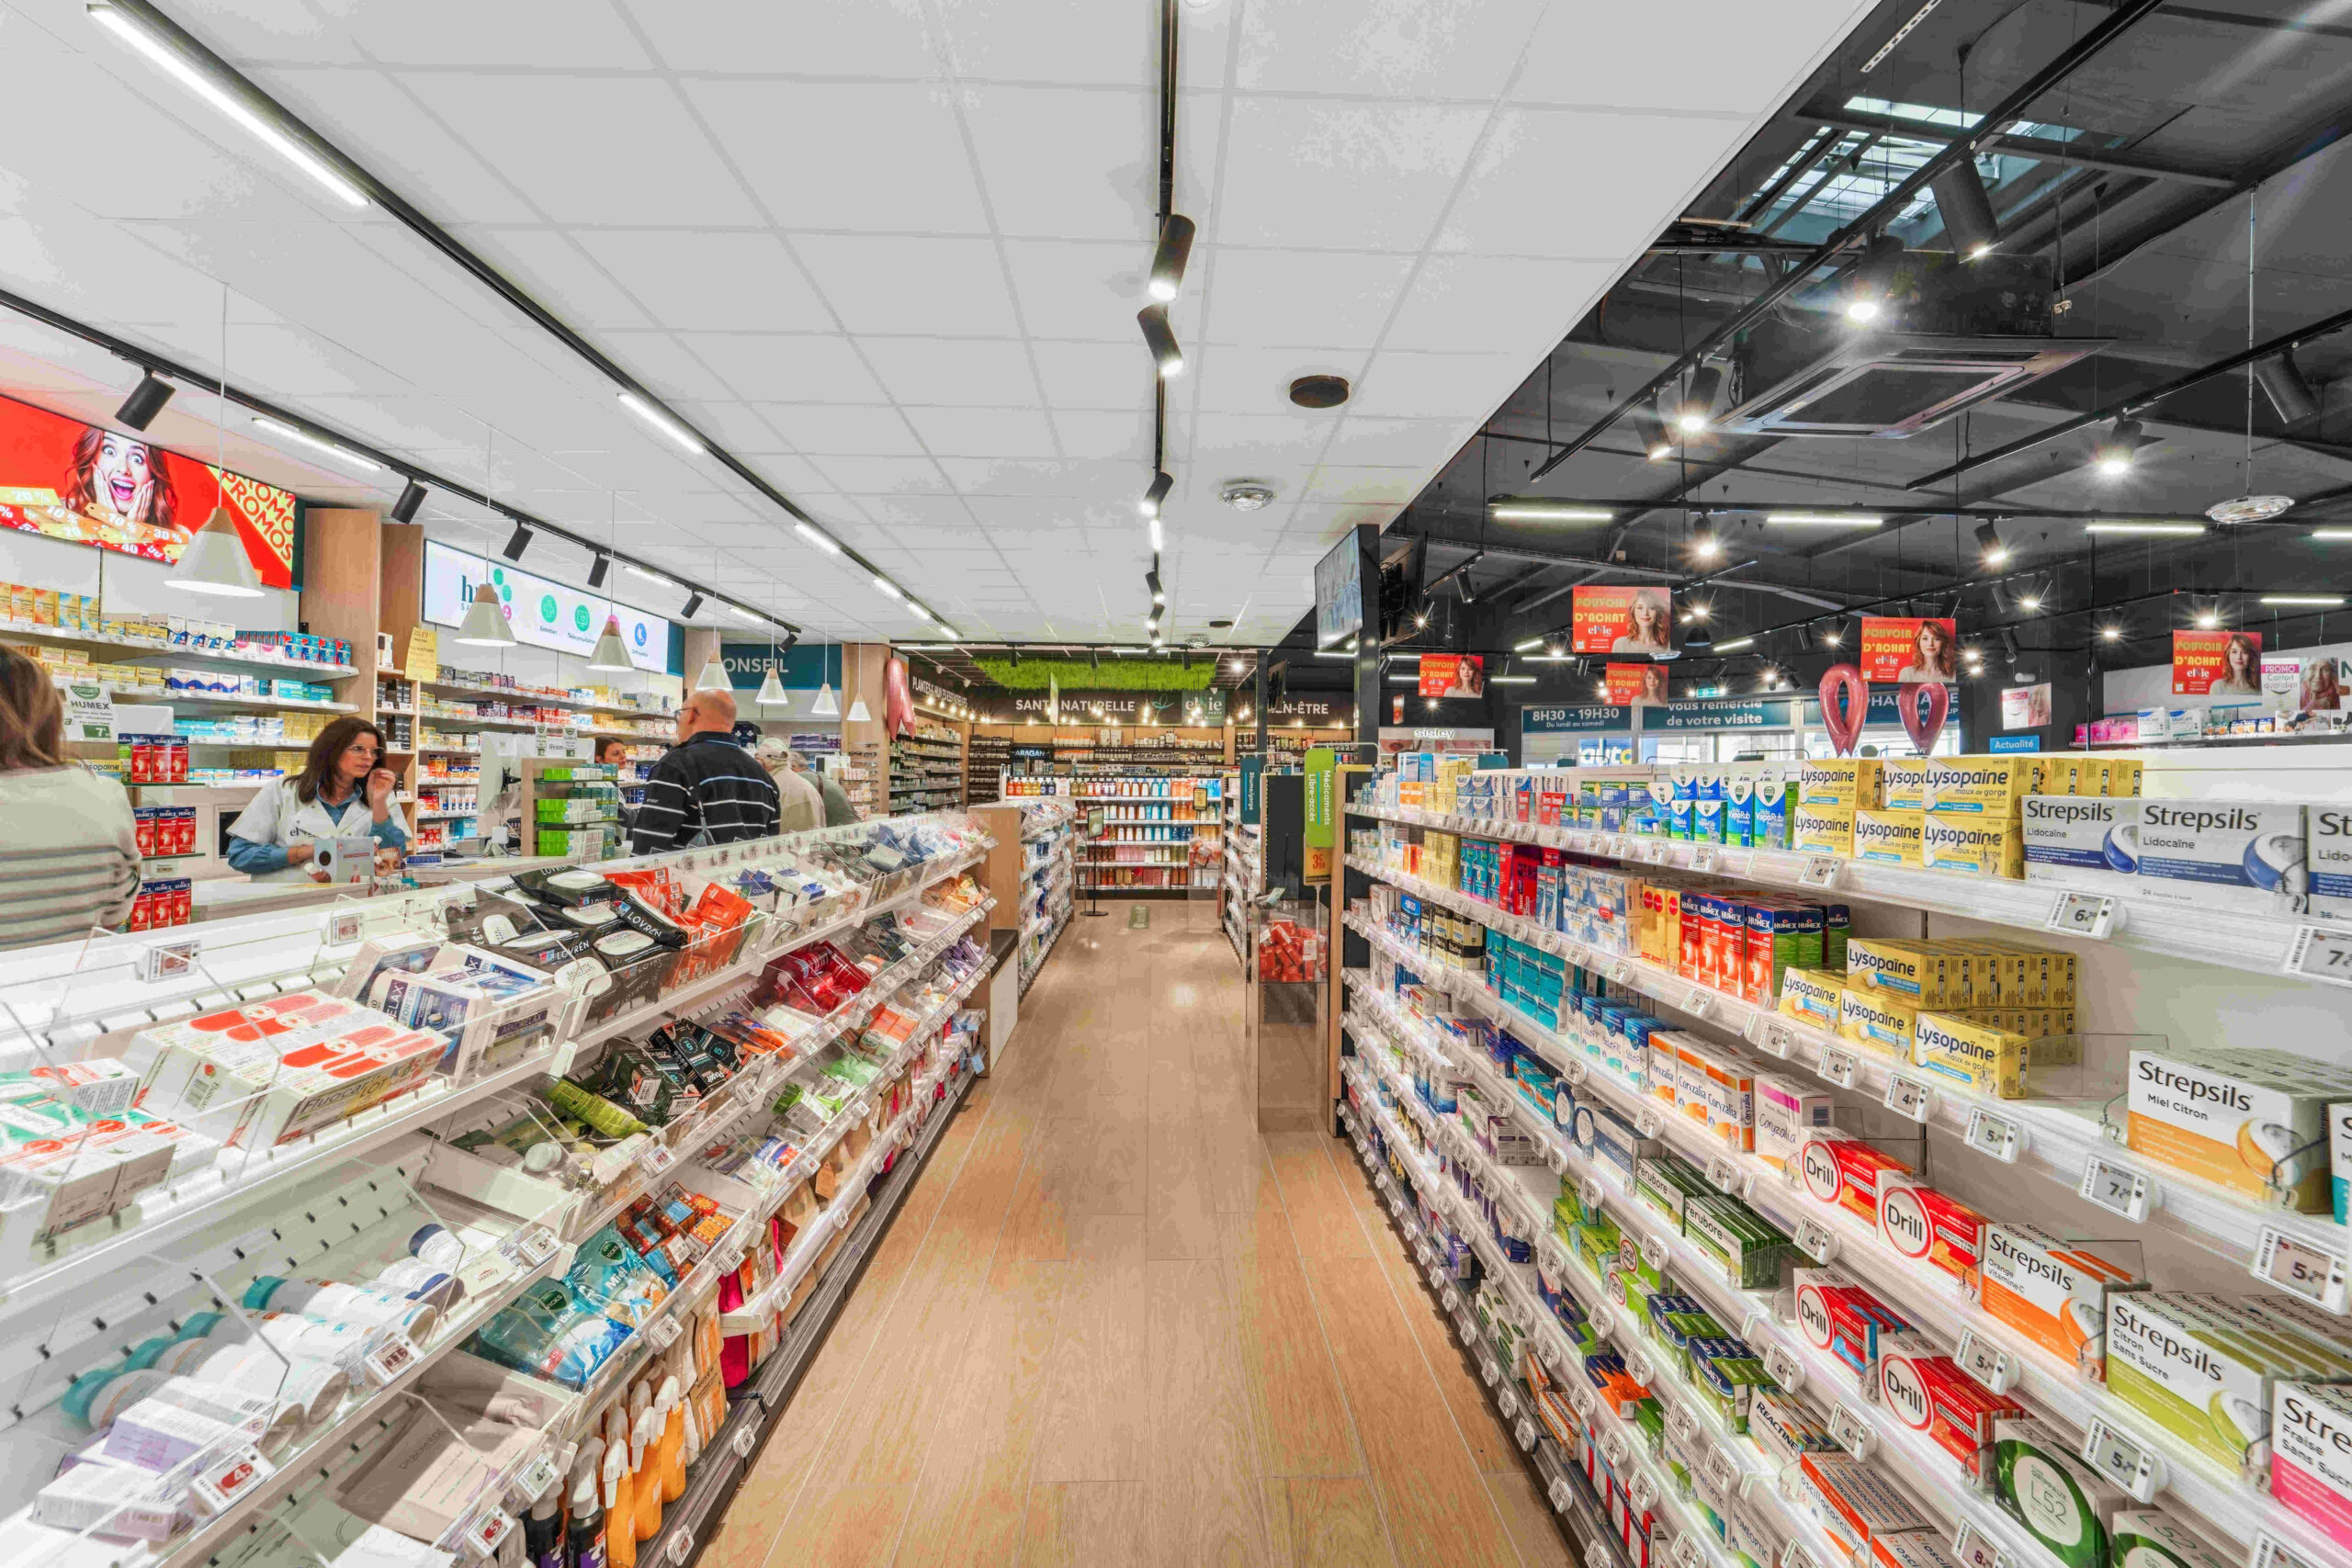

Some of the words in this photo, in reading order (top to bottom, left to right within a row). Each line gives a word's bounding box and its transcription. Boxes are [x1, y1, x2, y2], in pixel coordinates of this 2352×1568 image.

[1576, 598, 1625, 607] POUVOIR
[1575, 613, 1625, 622] D'ACHAT
[1864, 629, 1912, 638] POUVOIR
[1862, 644, 1911, 653] D'ACHAT
[2176, 642, 2222, 651] POUVOIR
[718, 658, 789, 673] ONSEIL
[2175, 656, 2222, 666] D'ACHAT
[2265, 665, 2295, 673] PROMO
[2264, 682, 2298, 690] quotidien
[71, 701, 110, 710] HUMEX
[1015, 700, 1049, 710] SANT
[1061, 701, 1135, 712] NATURELLE
[1532, 710, 1566, 721] 8H30
[1579, 708, 1619, 719] 19H30
[1668, 703, 1699, 712] vous
[1668, 715, 1683, 726] de
[1686, 716, 1721, 725] votre
[1724, 713, 1762, 724] visite
[1415, 728, 1453, 739] sisley
[1995, 739, 2034, 750] Actualité
[1801, 769, 1855, 785] Lysopaïne
[1926, 769, 2008, 788] Lysopaïne
[1984, 788, 2007, 797] gorge
[2027, 800, 2112, 823] Strepsils
[2143, 805, 2258, 833] Strepsils
[1795, 815, 1849, 833] Lysopaïne
[1856, 820, 1921, 840] Lysopaïne
[2027, 828, 2067, 839] Lidocaïne
[1925, 825, 2003, 847] Lysopaïne
[2143, 836, 2195, 850] Lidocaïne
[1681, 901, 1699, 911] HUMEX
[1701, 906, 1719, 918] HUMEX
[1721, 910, 1741, 922] HUMEX
[1747, 916, 1770, 930] HUMEX
[1774, 921, 1797, 930] HUMEX
[1798, 921, 1821, 930] HUMEX
[1849, 947, 1916, 976] Lysopaïne
[1784, 975, 1836, 1003] Lysopaïne
[1843, 998, 1905, 1032] Lysopaïne
[1917, 1023, 1995, 1061] Lysopaïne
[1679, 1076, 1706, 1100] Coryzalia
[2139, 1060, 2251, 1111] Strepsils
[1708, 1090, 1737, 1119] Coryzalia
[2148, 1093, 2169, 1108] Miel
[2173, 1102, 2209, 1121] Citron
[1758, 1114, 1796, 1144] Coryzalia
[1638, 1162, 1668, 1194] Perubore
[1806, 1156, 1834, 1188] Drill
[1686, 1203, 1723, 1239] Perubore
[1888, 1204, 1923, 1242] Drill
[1988, 1258, 2014, 1278] Orange
[1990, 1233, 2074, 1291] Strepsils
[605, 1268, 628, 1290] Miel
[1988, 1268, 2018, 1291] Vitamine
[1802, 1301, 1826, 1335] Drill
[2114, 1328, 2144, 1352] Citron
[2114, 1304, 2223, 1382] Strepsils
[2113, 1340, 2137, 1360] Sans
[2139, 1356, 2169, 1380] Sucre
[1697, 1357, 1722, 1387] HUMEX
[1888, 1370, 1923, 1415] Drill
[1756, 1402, 1799, 1451] REACTINE
[2282, 1424, 2324, 1456] Fraise
[2282, 1438, 2313, 1466] Sans
[2030, 1480, 2067, 1526] L52
